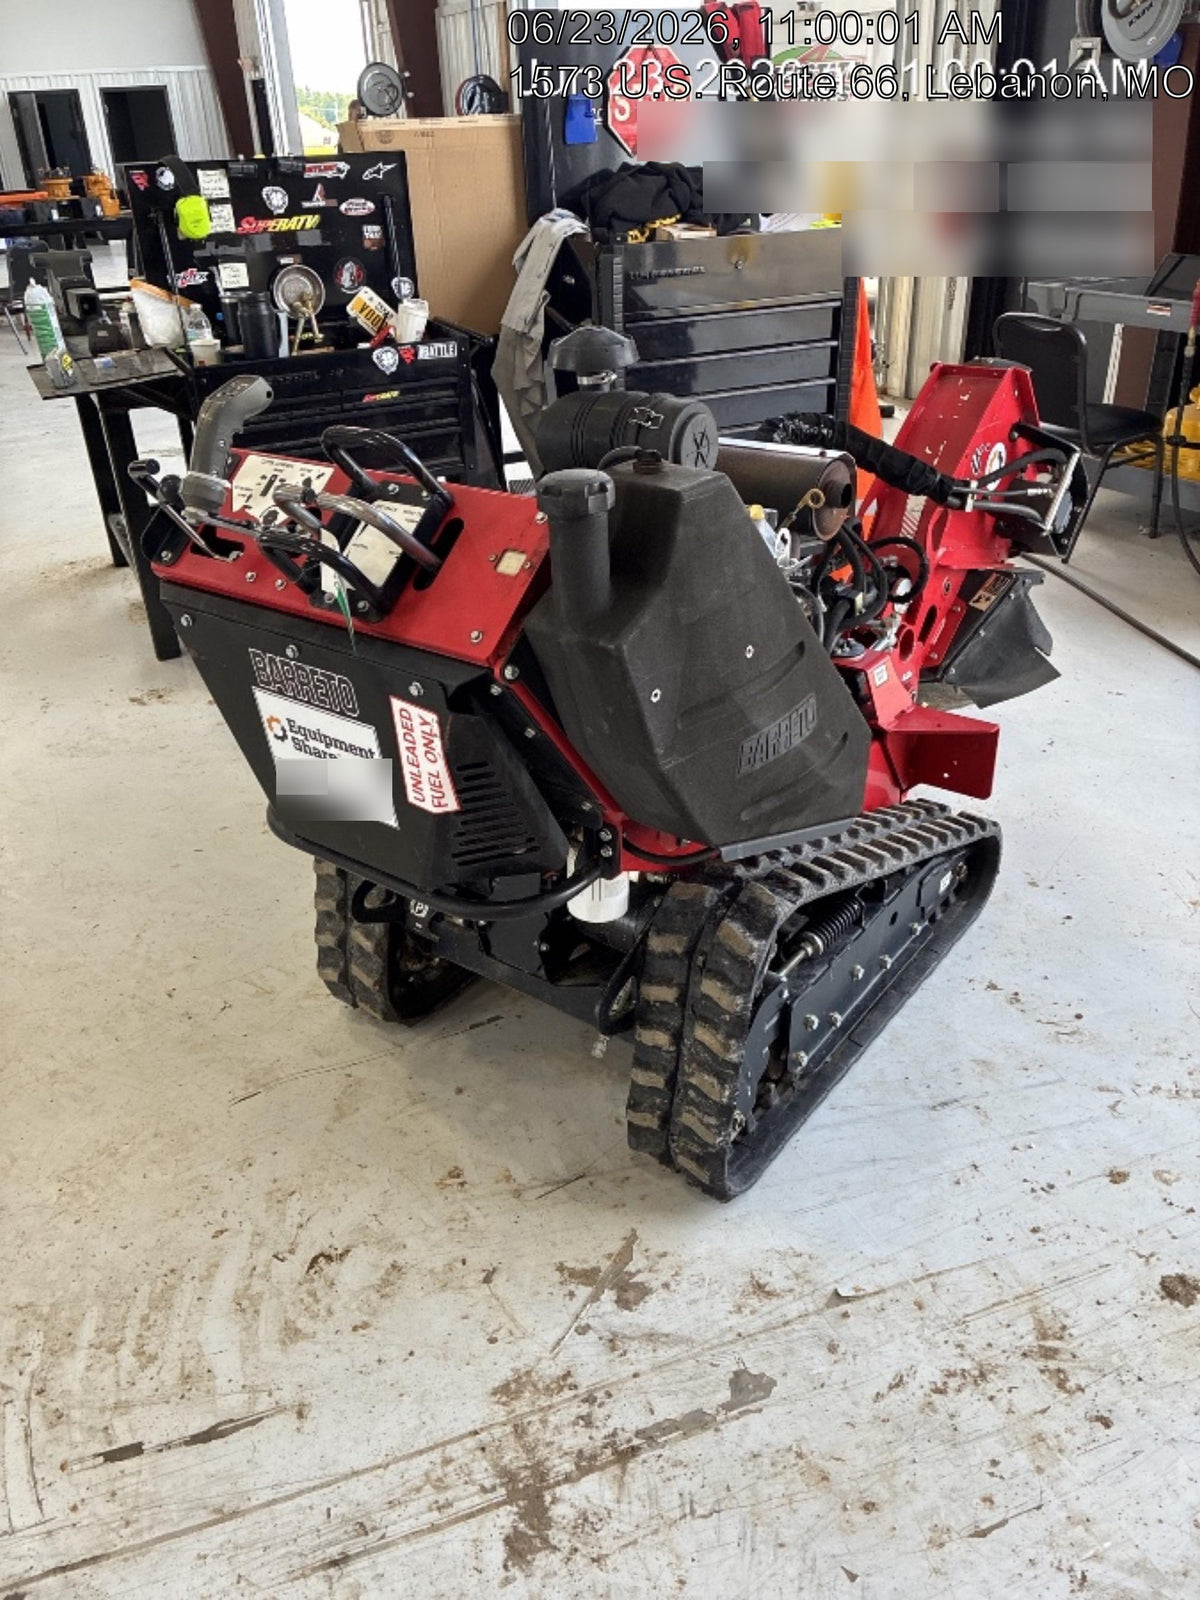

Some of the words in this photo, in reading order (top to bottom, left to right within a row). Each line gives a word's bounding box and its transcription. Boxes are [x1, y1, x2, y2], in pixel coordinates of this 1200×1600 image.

[248, 647, 360, 717] BARRETO
[286, 717, 375, 757] Equipment
[399, 708, 426, 803] UNLEADED
[417, 714, 441, 764] ONLY
[737, 693, 817, 774] BARRETO
[429, 769, 449, 809] FUEL
